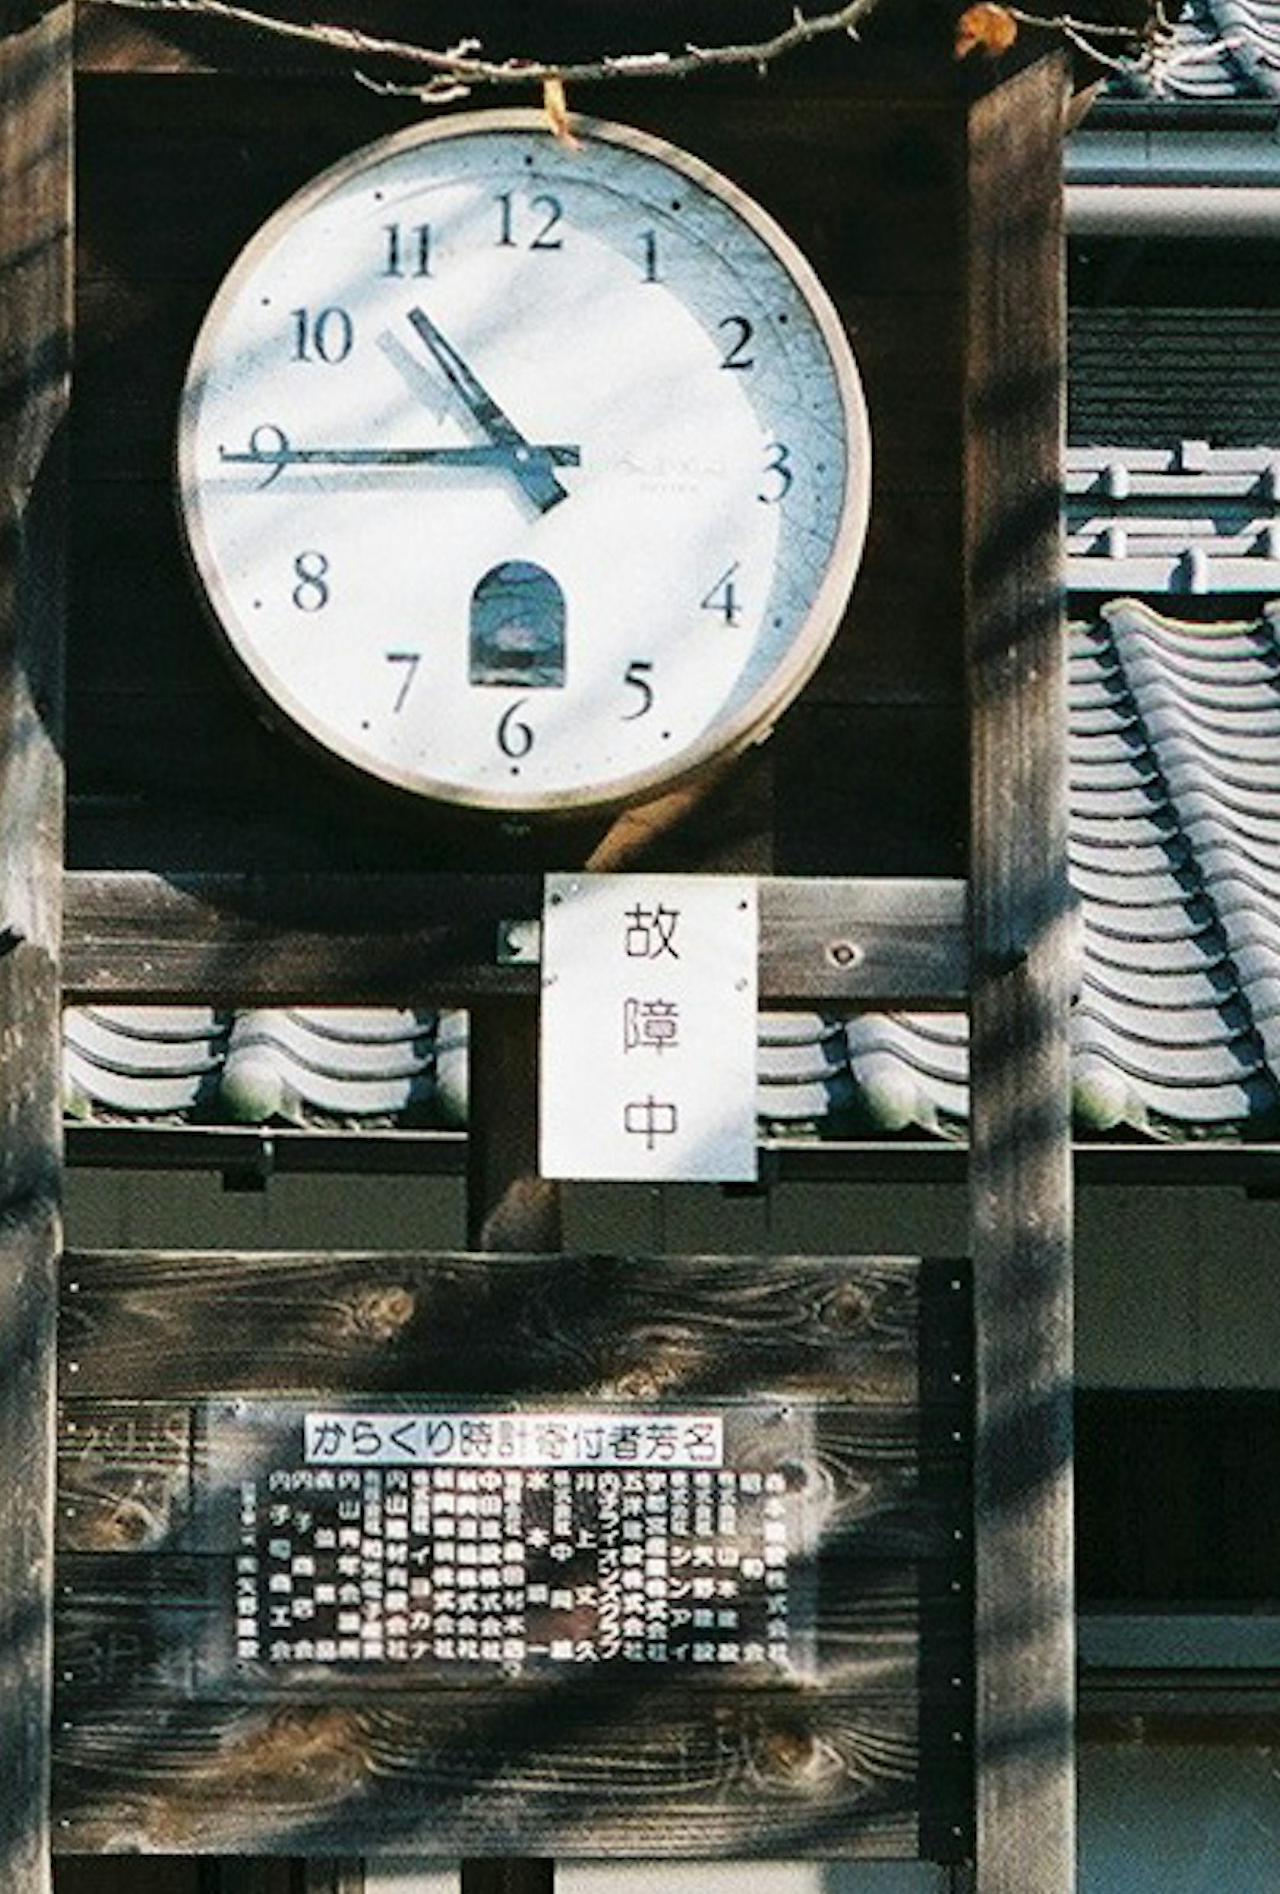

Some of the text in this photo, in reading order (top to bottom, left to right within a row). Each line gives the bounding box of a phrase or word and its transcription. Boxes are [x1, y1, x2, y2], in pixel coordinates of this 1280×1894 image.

[381, 221, 432, 279] 11
[492, 195, 564, 250] 12
[639, 231, 664, 284] 1
[289, 306, 354, 365] 10
[719, 315, 755, 371] 2
[248, 424, 290, 490] 9
[757, 441, 793, 505] 3
[292, 551, 330, 612] 8
[700, 562, 742, 628] 4
[385, 653, 421, 713] 7
[622, 660, 655, 720] 5
[496, 699, 535, 759] 6
[623, 902, 680, 1150] 故障中
[313, 1420, 716, 1462] からくり時計寄付者芳名
